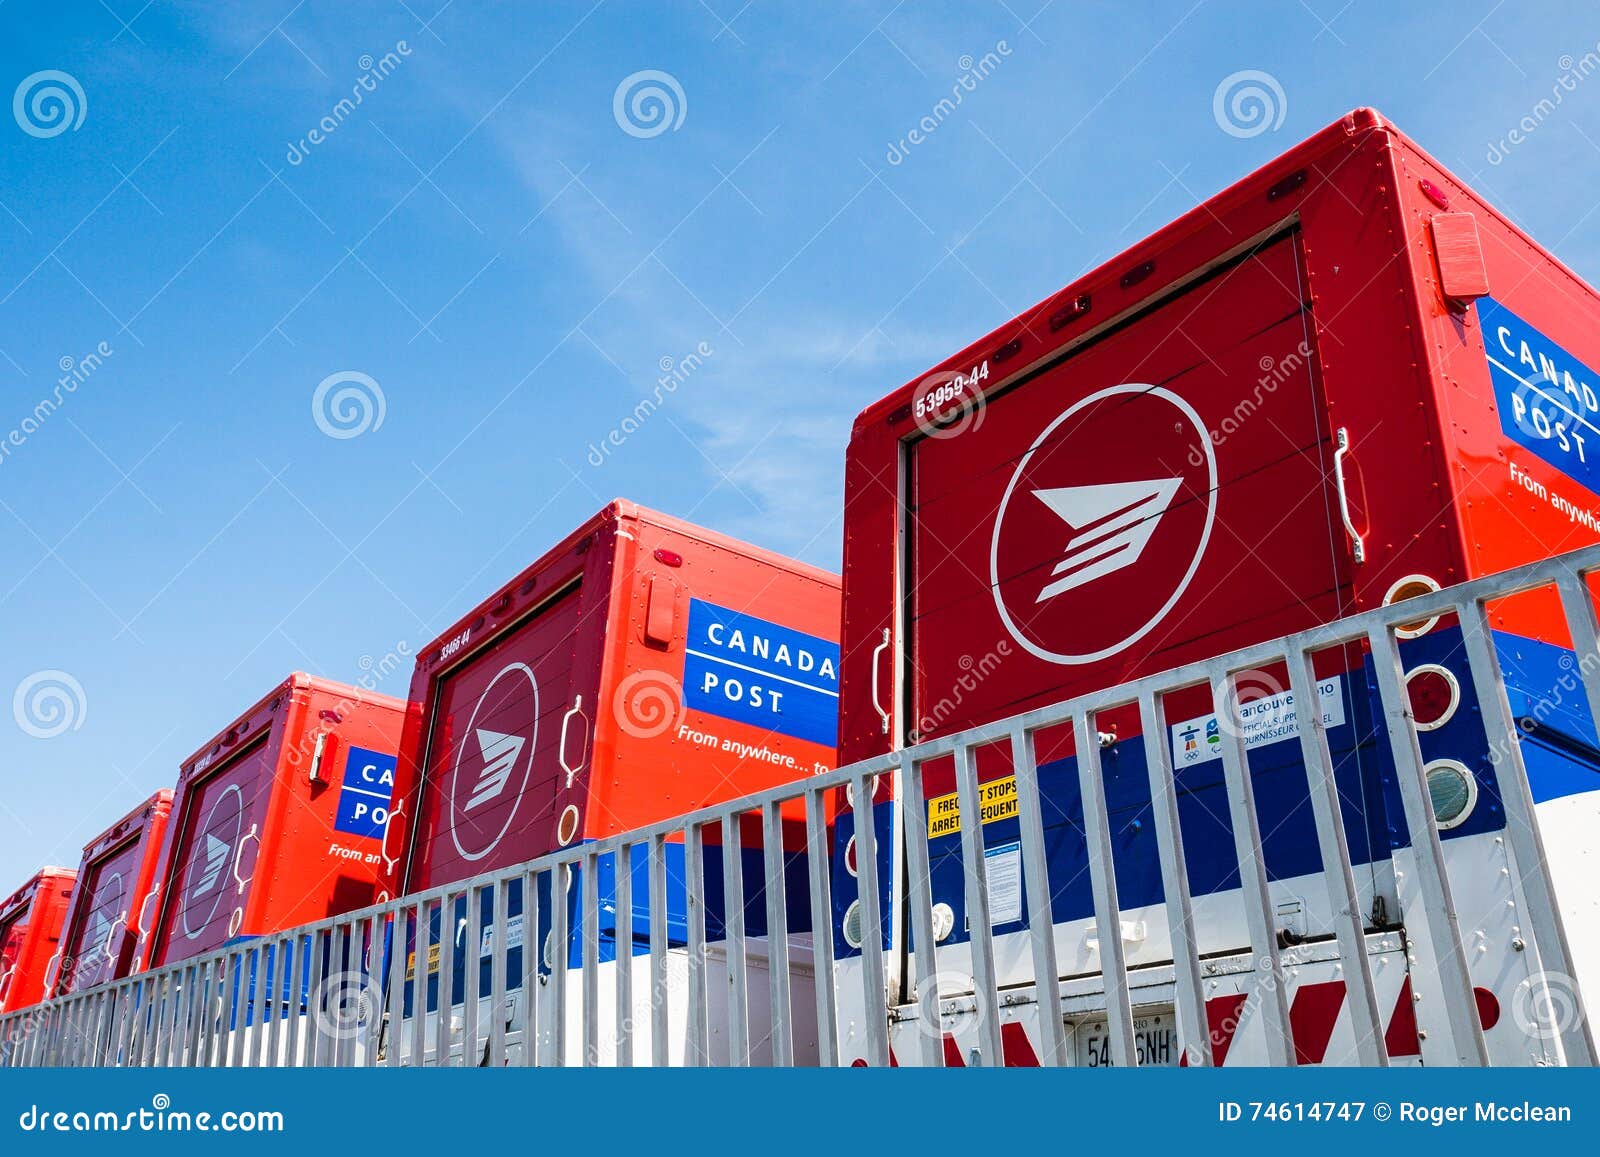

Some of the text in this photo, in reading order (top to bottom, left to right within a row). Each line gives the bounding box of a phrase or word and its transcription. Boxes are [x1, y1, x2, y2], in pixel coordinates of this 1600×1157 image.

[916, 360, 989, 418] 53959-44
[1497, 326, 1600, 413] CANAD
[1511, 391, 1586, 463] POST
[1509, 461, 1600, 534] From anywhe
[707, 623, 836, 680] CANADA
[703, 672, 783, 713] POST
[1241, 695, 1293, 718] ancouve
[678, 725, 829, 775] From anywhere... to
[988, 780, 1017, 799] STOPS
[931, 813, 960, 834] ARRÊT
[328, 843, 362, 860] From
